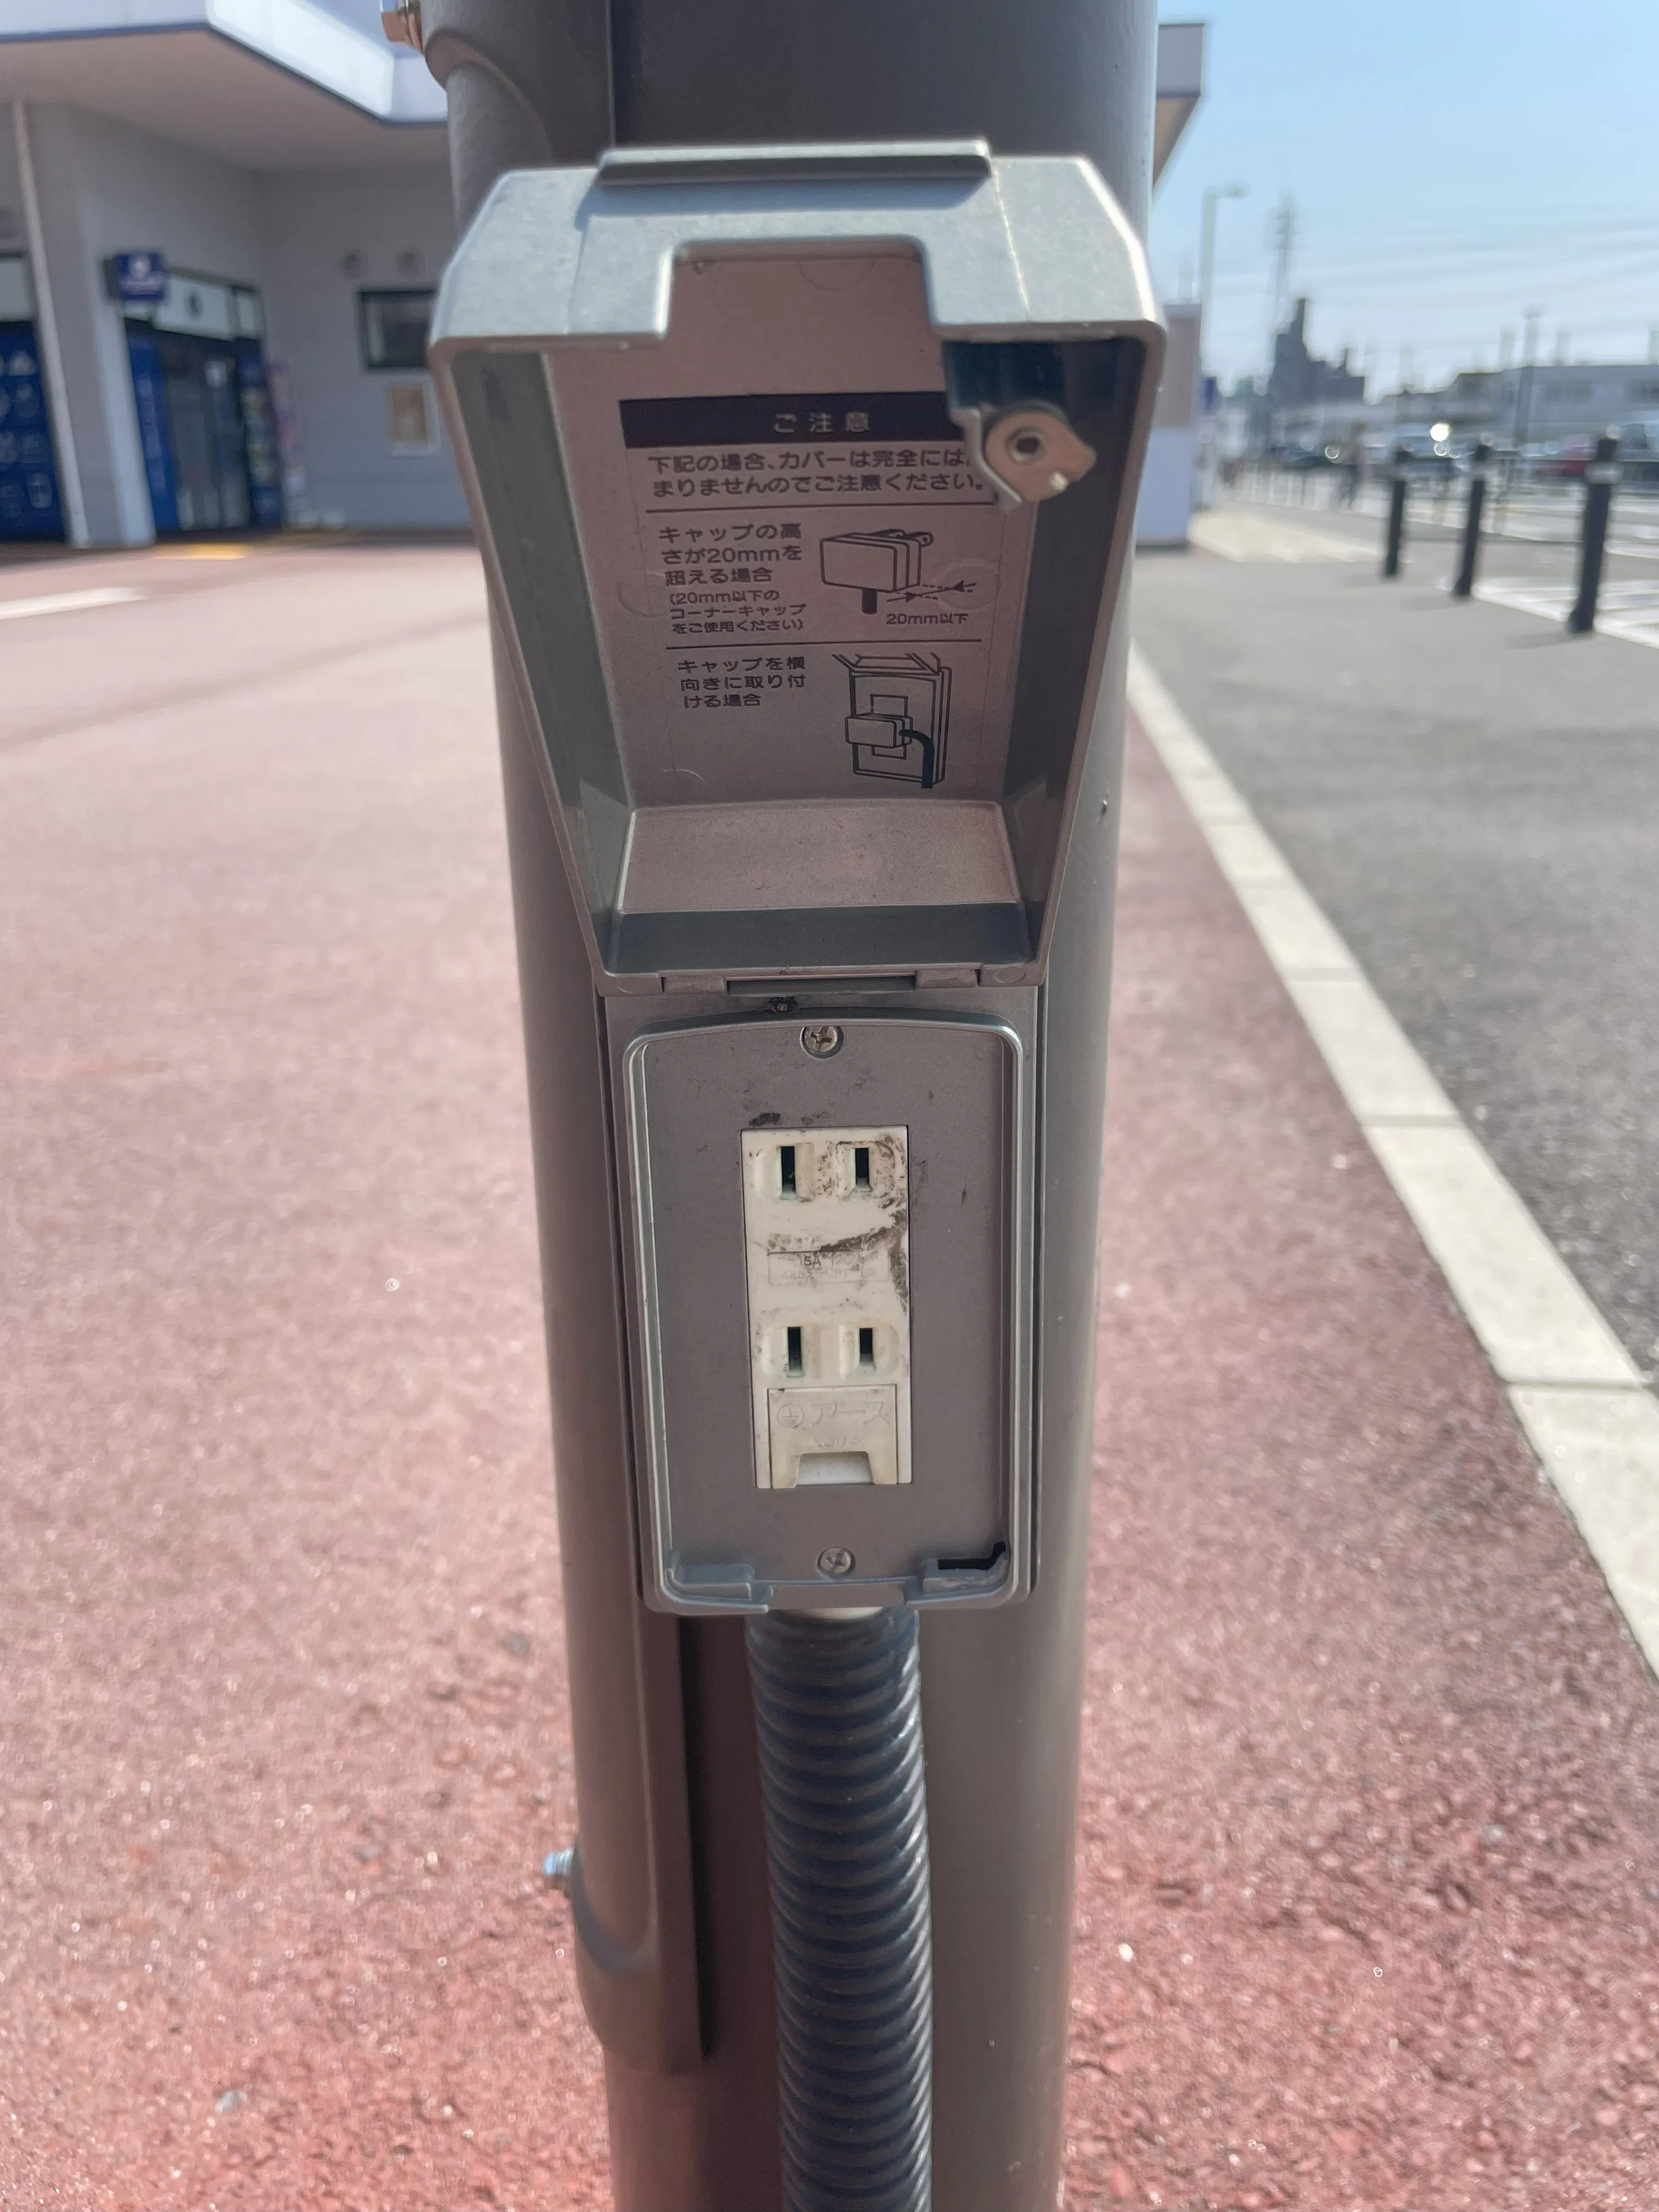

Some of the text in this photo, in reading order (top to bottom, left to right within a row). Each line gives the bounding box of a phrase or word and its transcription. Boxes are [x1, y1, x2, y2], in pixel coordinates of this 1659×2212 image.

[648, 449, 970, 474] 下記の場合、カバーは完全には
[653, 472, 983, 498] まりませんのでご注意ください。
[658, 522, 802, 544] キャップの高
[661, 545, 803, 565] さが20mmを
[665, 567, 772, 586] 超える場合
[669, 590, 780, 606] (20mm以下の
[669, 603, 806, 619] コーナーキャップ
[887, 612, 968, 625] 20mm以下
[678, 656, 805, 674] キャップを横
[681, 674, 806, 692] 向きに取り付
[684, 693, 761, 709] ける場合
[810, 1400, 890, 1427] アース
